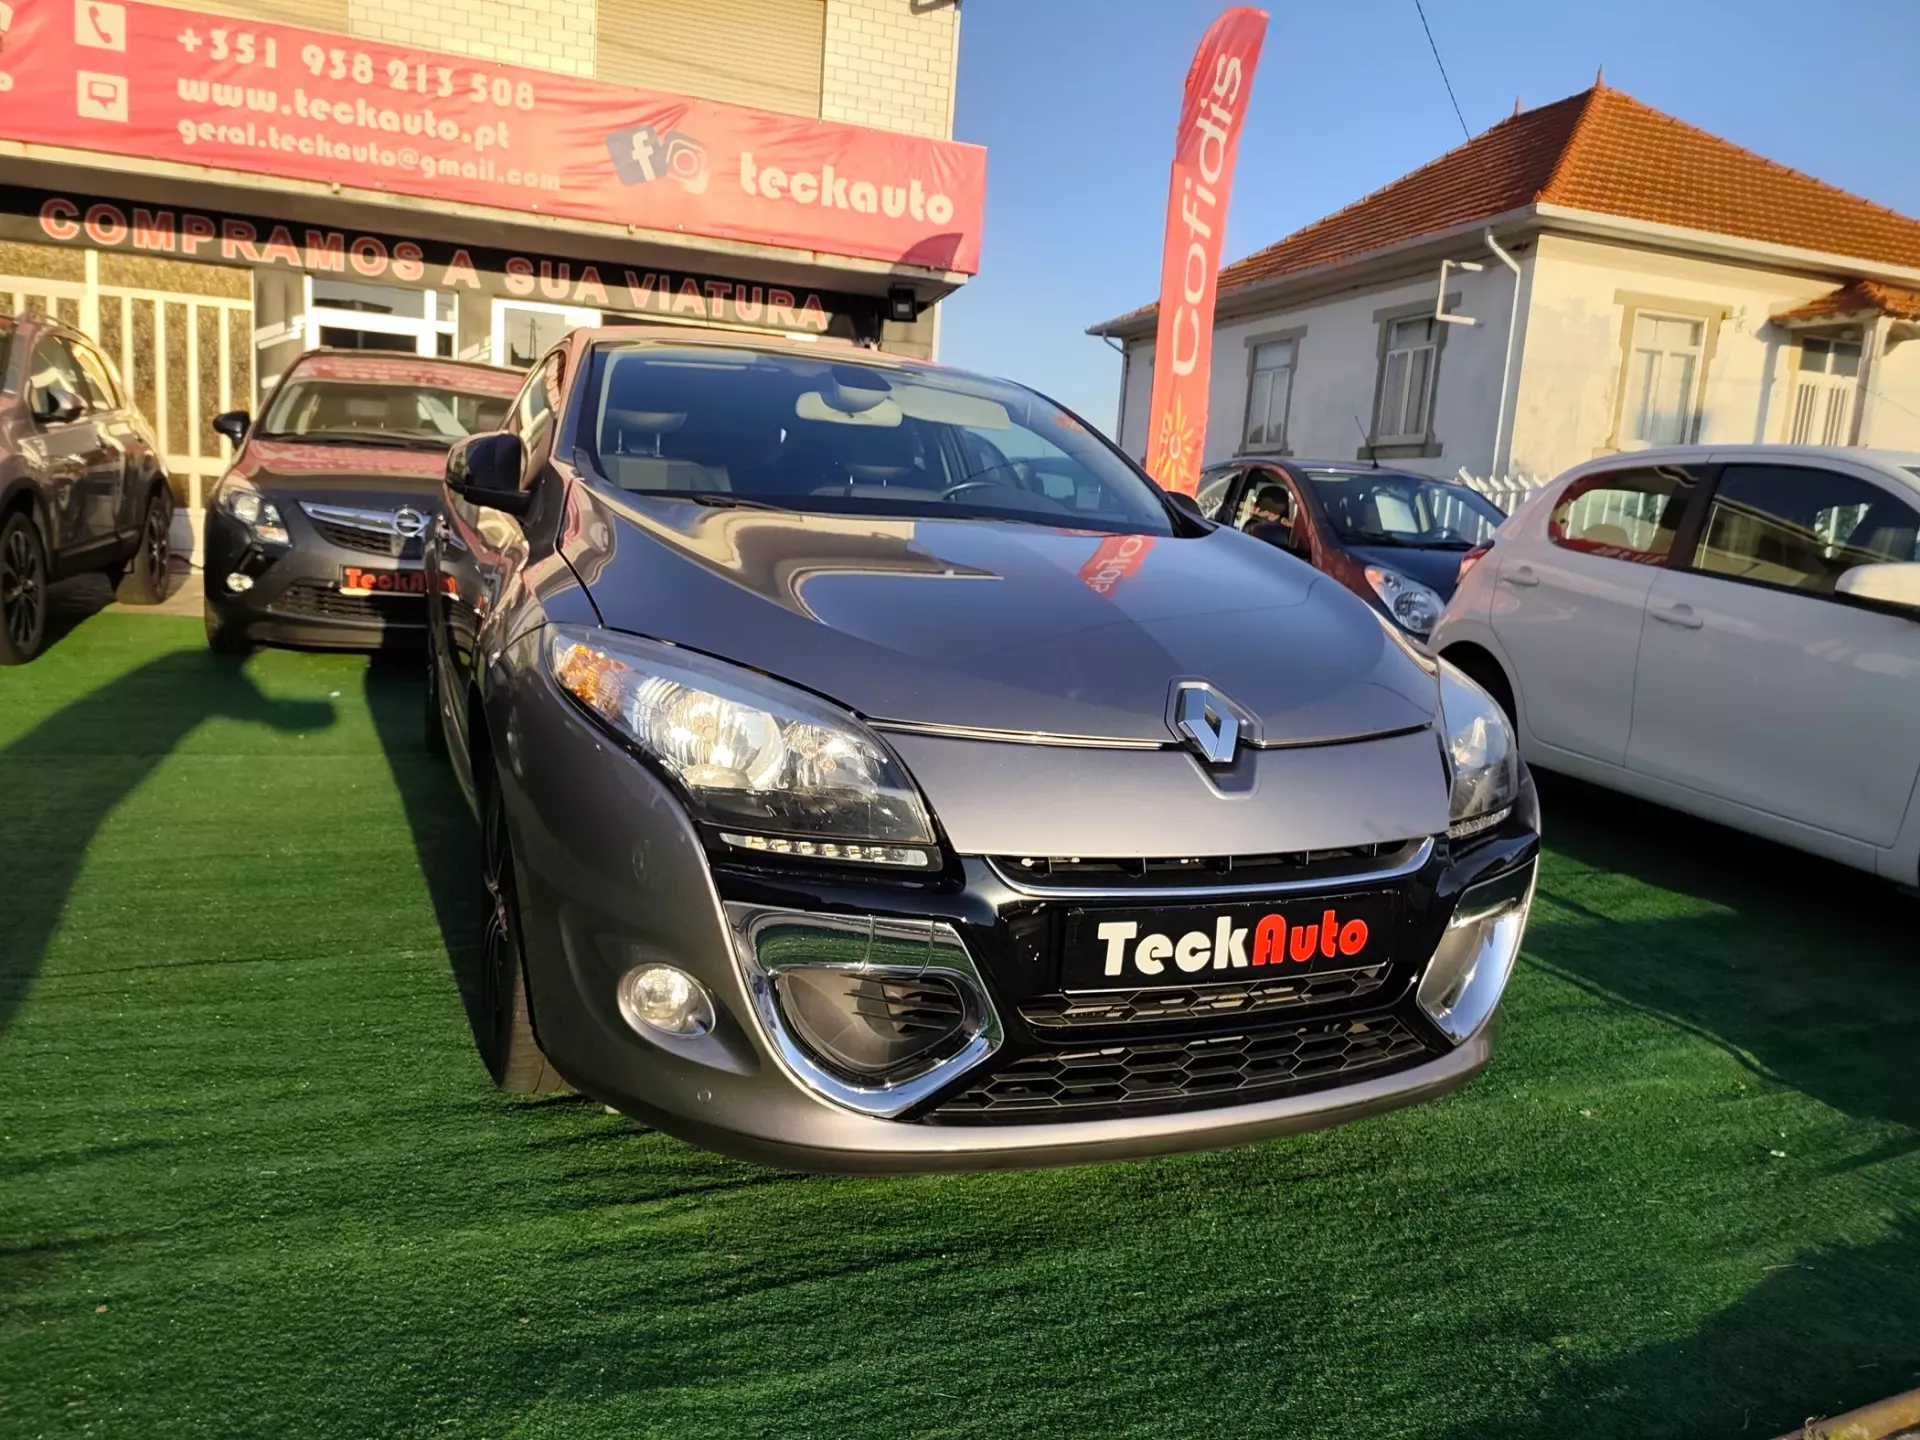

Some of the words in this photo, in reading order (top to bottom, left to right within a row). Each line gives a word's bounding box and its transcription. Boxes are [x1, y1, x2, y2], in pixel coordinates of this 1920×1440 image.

[177, 28, 277, 69] +351
[302, 44, 374, 85] 938
[387, 59, 454, 98] 213
[469, 73, 535, 111] 508
[177, 78, 510, 152] www.teckauto.pt
[177, 119, 562, 191] geral.teckauto@gmail.com
[740, 151, 955, 226] teckauto
[39, 198, 425, 282] COMPRAMOS
[441, 248, 482, 290] A
[504, 255, 610, 306] SUA
[623, 269, 830, 331] VIATURA
[1097, 909, 1369, 977] TeckAuto
